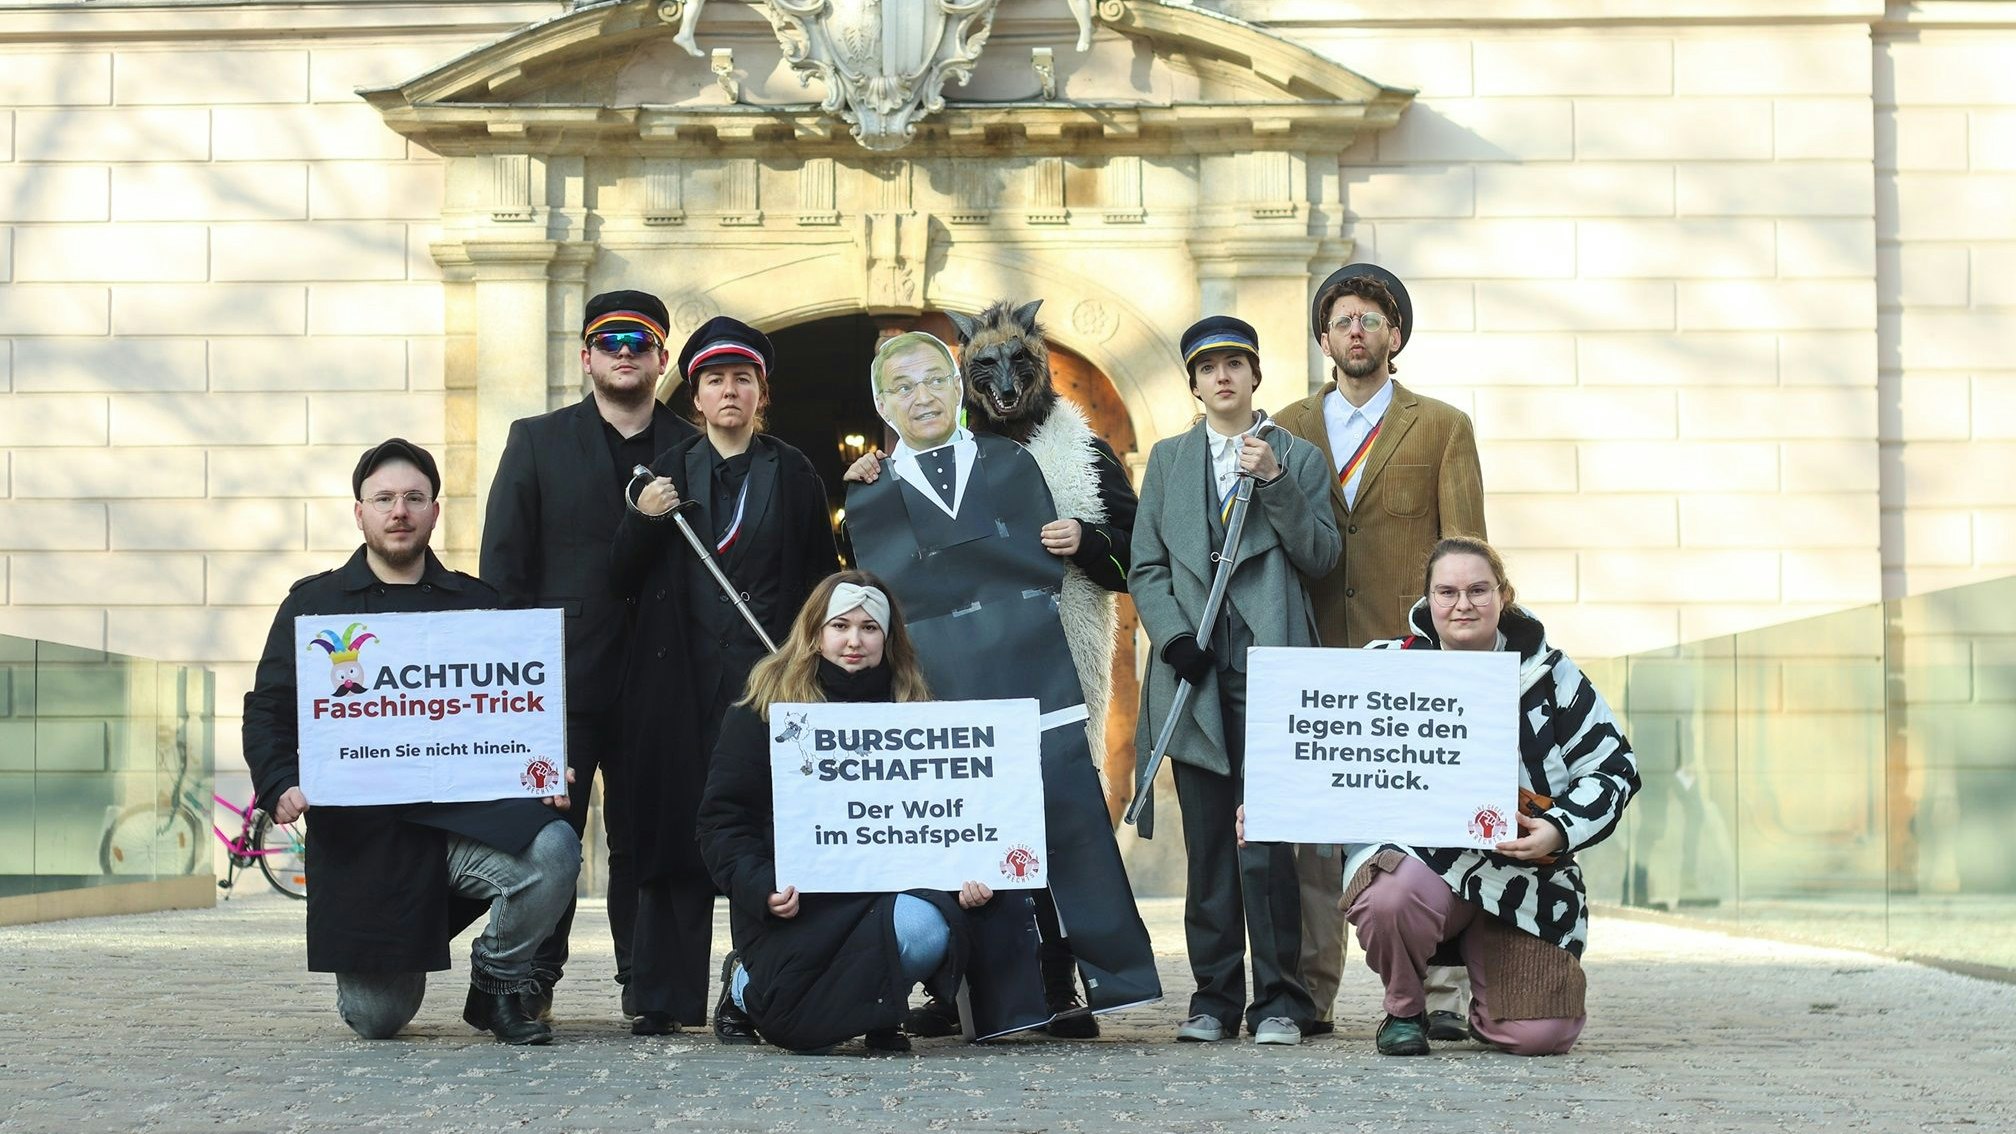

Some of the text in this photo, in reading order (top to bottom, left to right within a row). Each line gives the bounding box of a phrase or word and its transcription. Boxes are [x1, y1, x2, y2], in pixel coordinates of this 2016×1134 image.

[373, 661, 545, 690] ACHTUNG
[313, 690, 545, 720] Faschings-Trick
[1301, 690, 1464, 716] Herr Stelzer,
[815, 726, 994, 751] BURSCHEN
[1289, 715, 1467, 739] legen Sie den
[340, 740, 531, 759] Fallen Sie nicht hinein.
[1295, 742, 1460, 765] Ehrenschutz
[819, 756, 993, 781] SCHAFTEN
[1332, 769, 1429, 790] zurück.
[848, 798, 963, 819] Der Wolf
[815, 823, 998, 847] im Schafspelz
